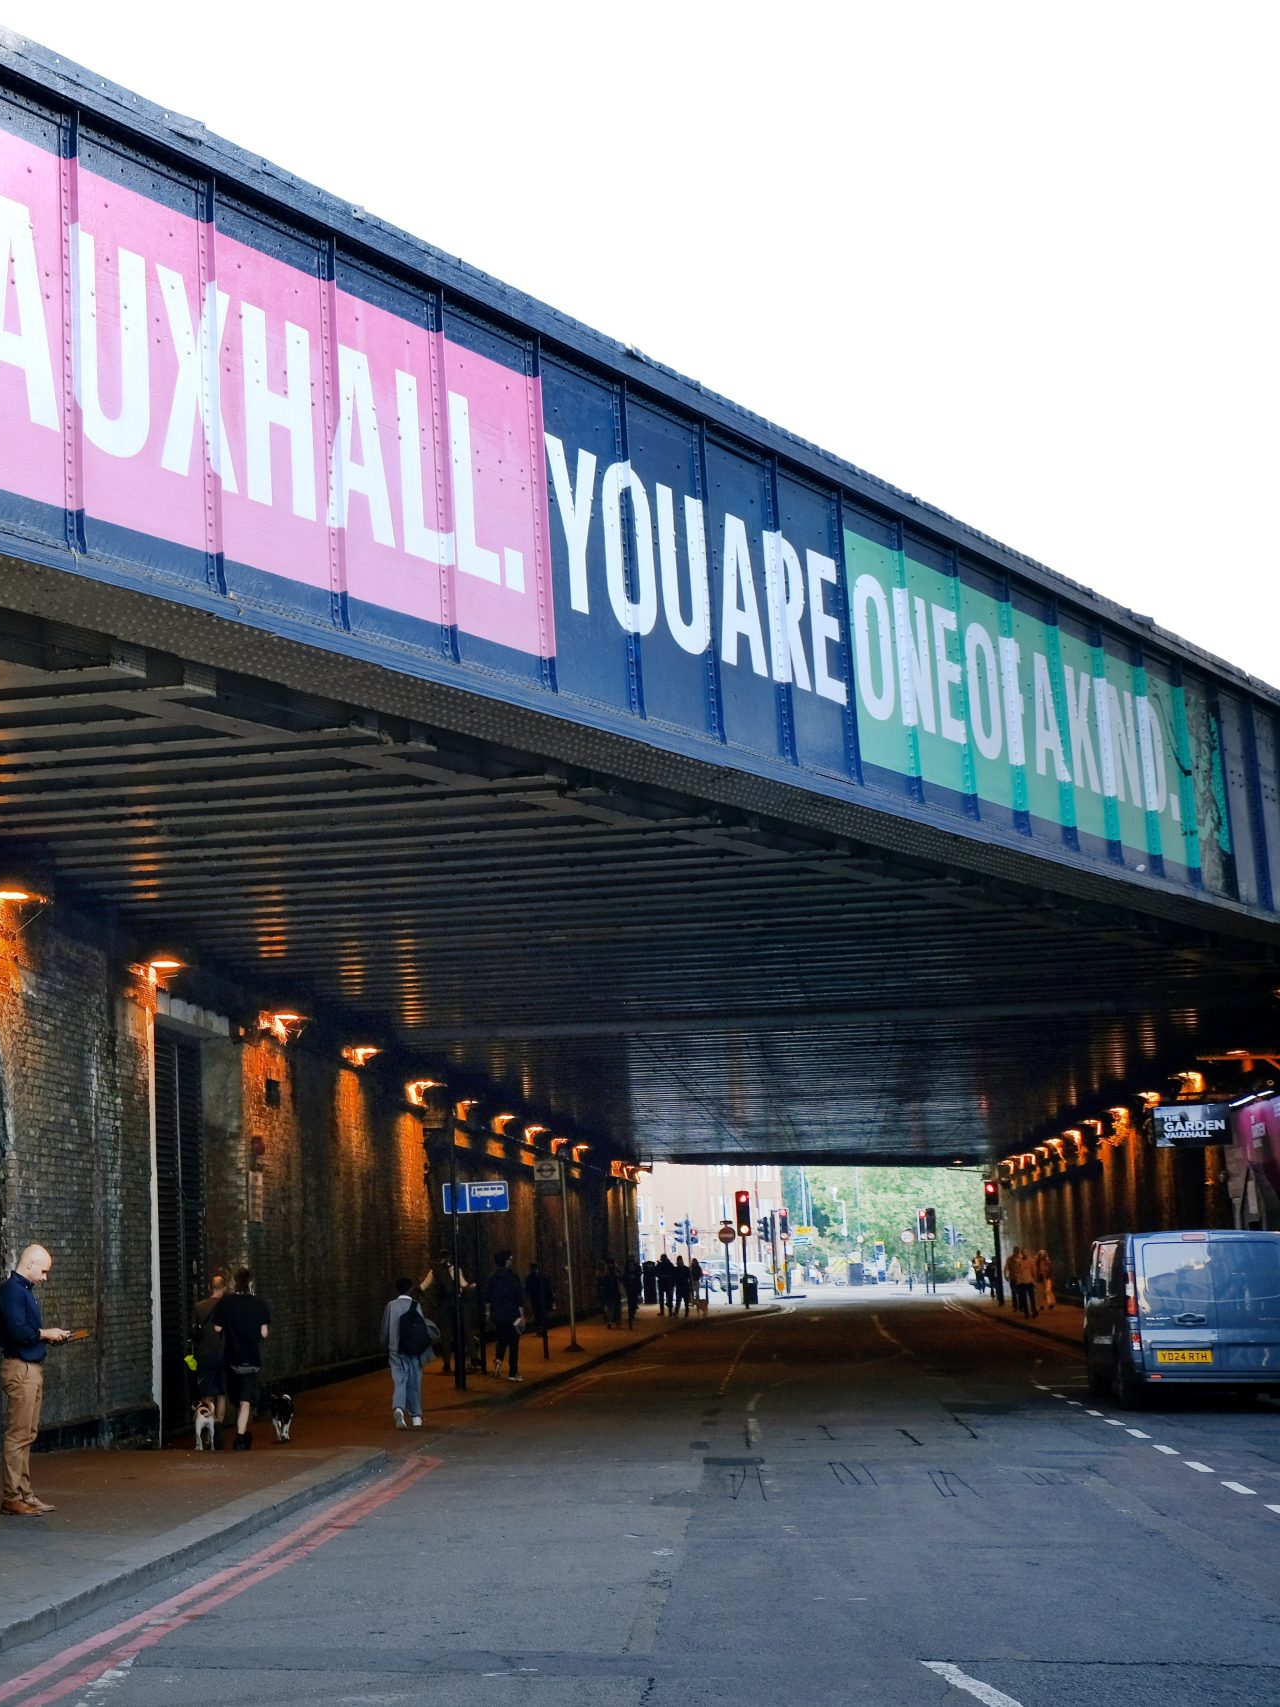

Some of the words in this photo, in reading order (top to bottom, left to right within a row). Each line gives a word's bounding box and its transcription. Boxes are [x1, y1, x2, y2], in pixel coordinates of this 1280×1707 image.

[544, 433, 711, 655] YOU
[721, 513, 847, 706] ARE
[852, 573, 965, 744] ONE
[965, 622, 1025, 766] OF
[1034, 651, 1072, 783] A
[1064, 665, 1181, 822] KIND.
[1163, 1120, 1225, 1132] GARDEN
[1164, 1131, 1212, 1139] VAUXHALL
[1189, 1352, 1207, 1360] RTH
